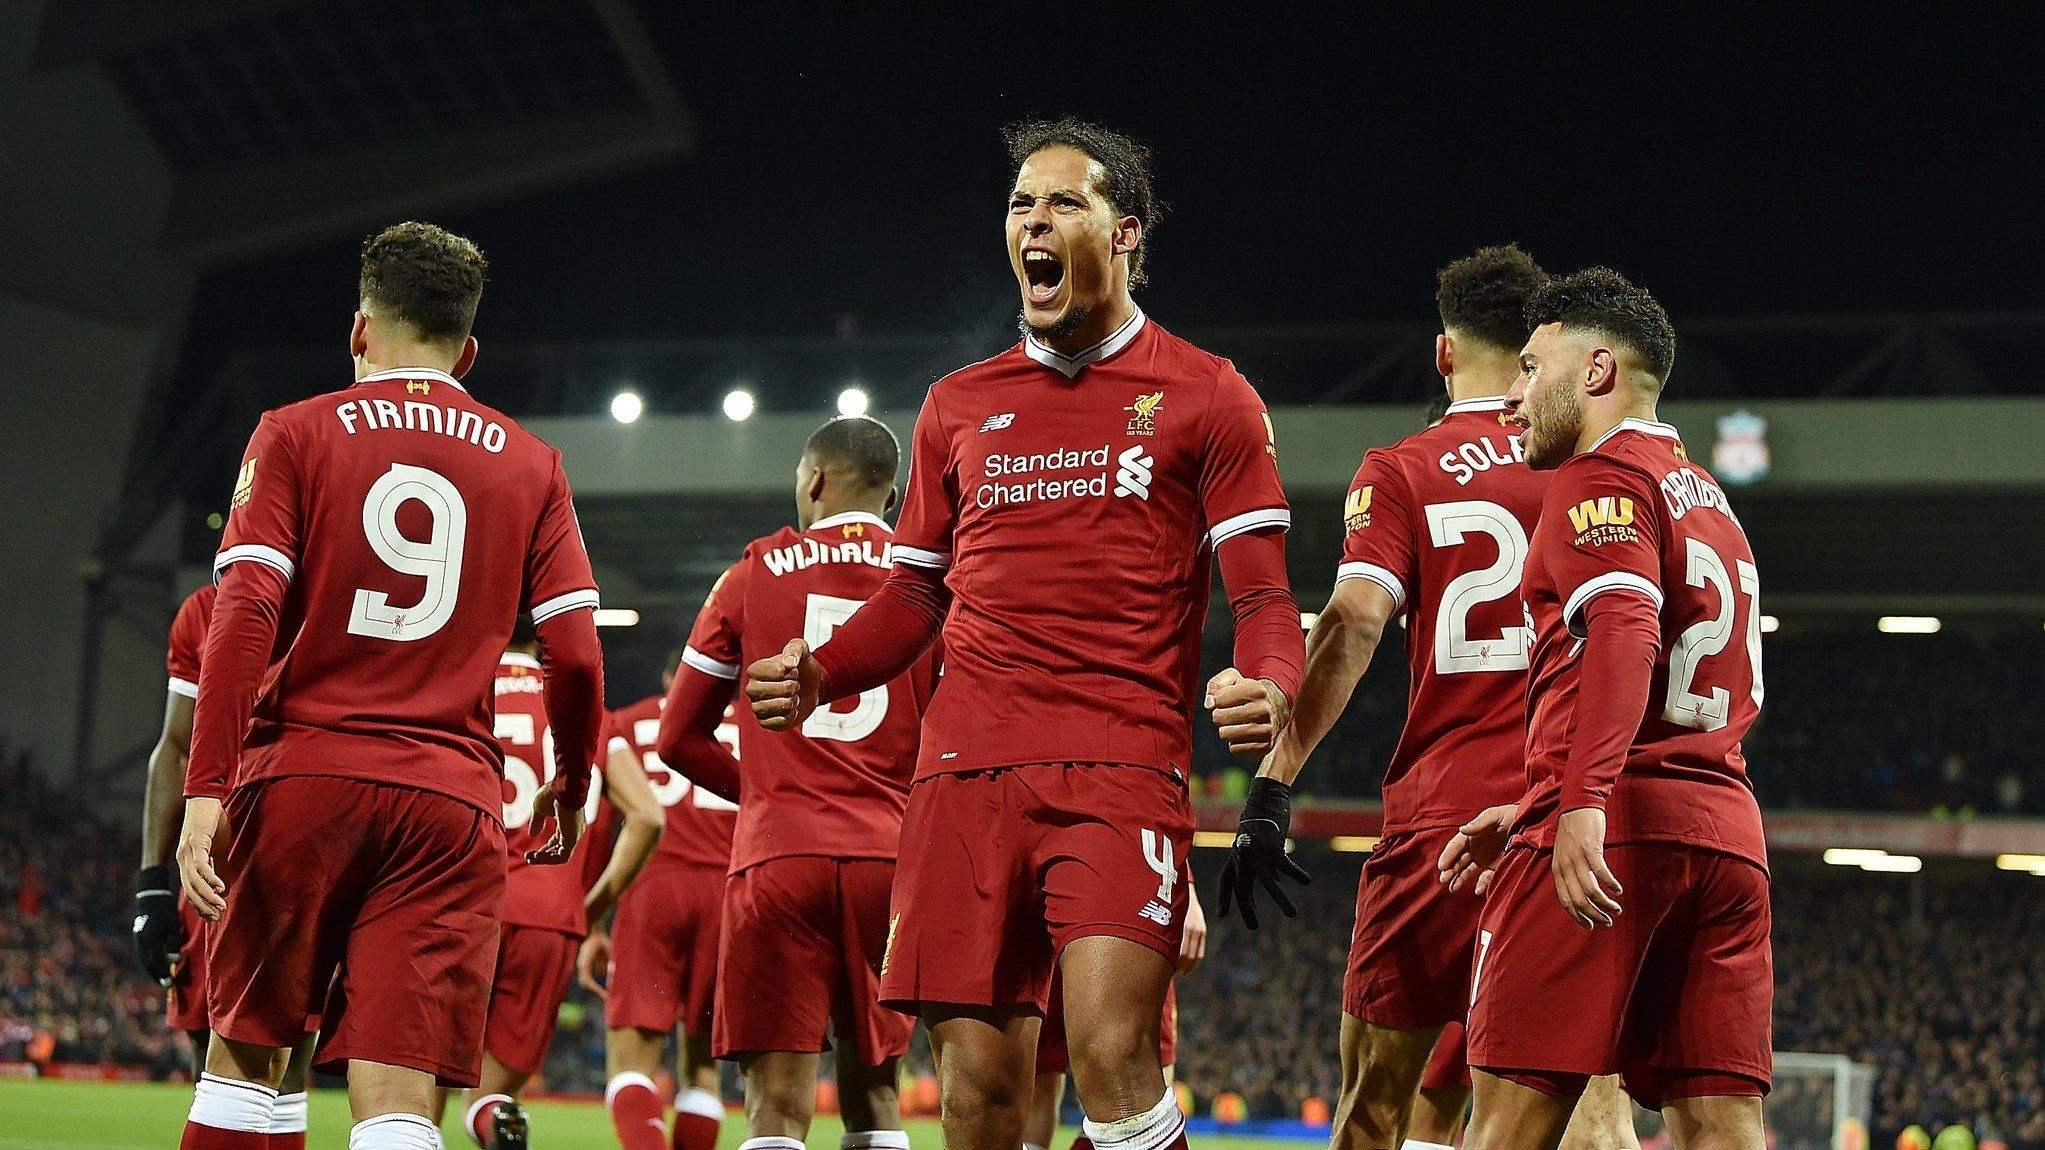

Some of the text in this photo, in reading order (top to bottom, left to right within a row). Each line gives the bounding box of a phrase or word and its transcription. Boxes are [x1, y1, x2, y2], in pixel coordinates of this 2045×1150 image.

[336, 399, 508, 454] FIRMINO
[983, 444, 1111, 479] Standard
[975, 471, 1108, 510] Chartered
[1566, 496, 1635, 534] WU
[346, 462, 468, 642] 9
[1574, 526, 1638, 546] WESTERN
[1593, 534, 1640, 547] UNION
[1423, 500, 1530, 675] 2
[1140, 827, 1178, 905] 4
